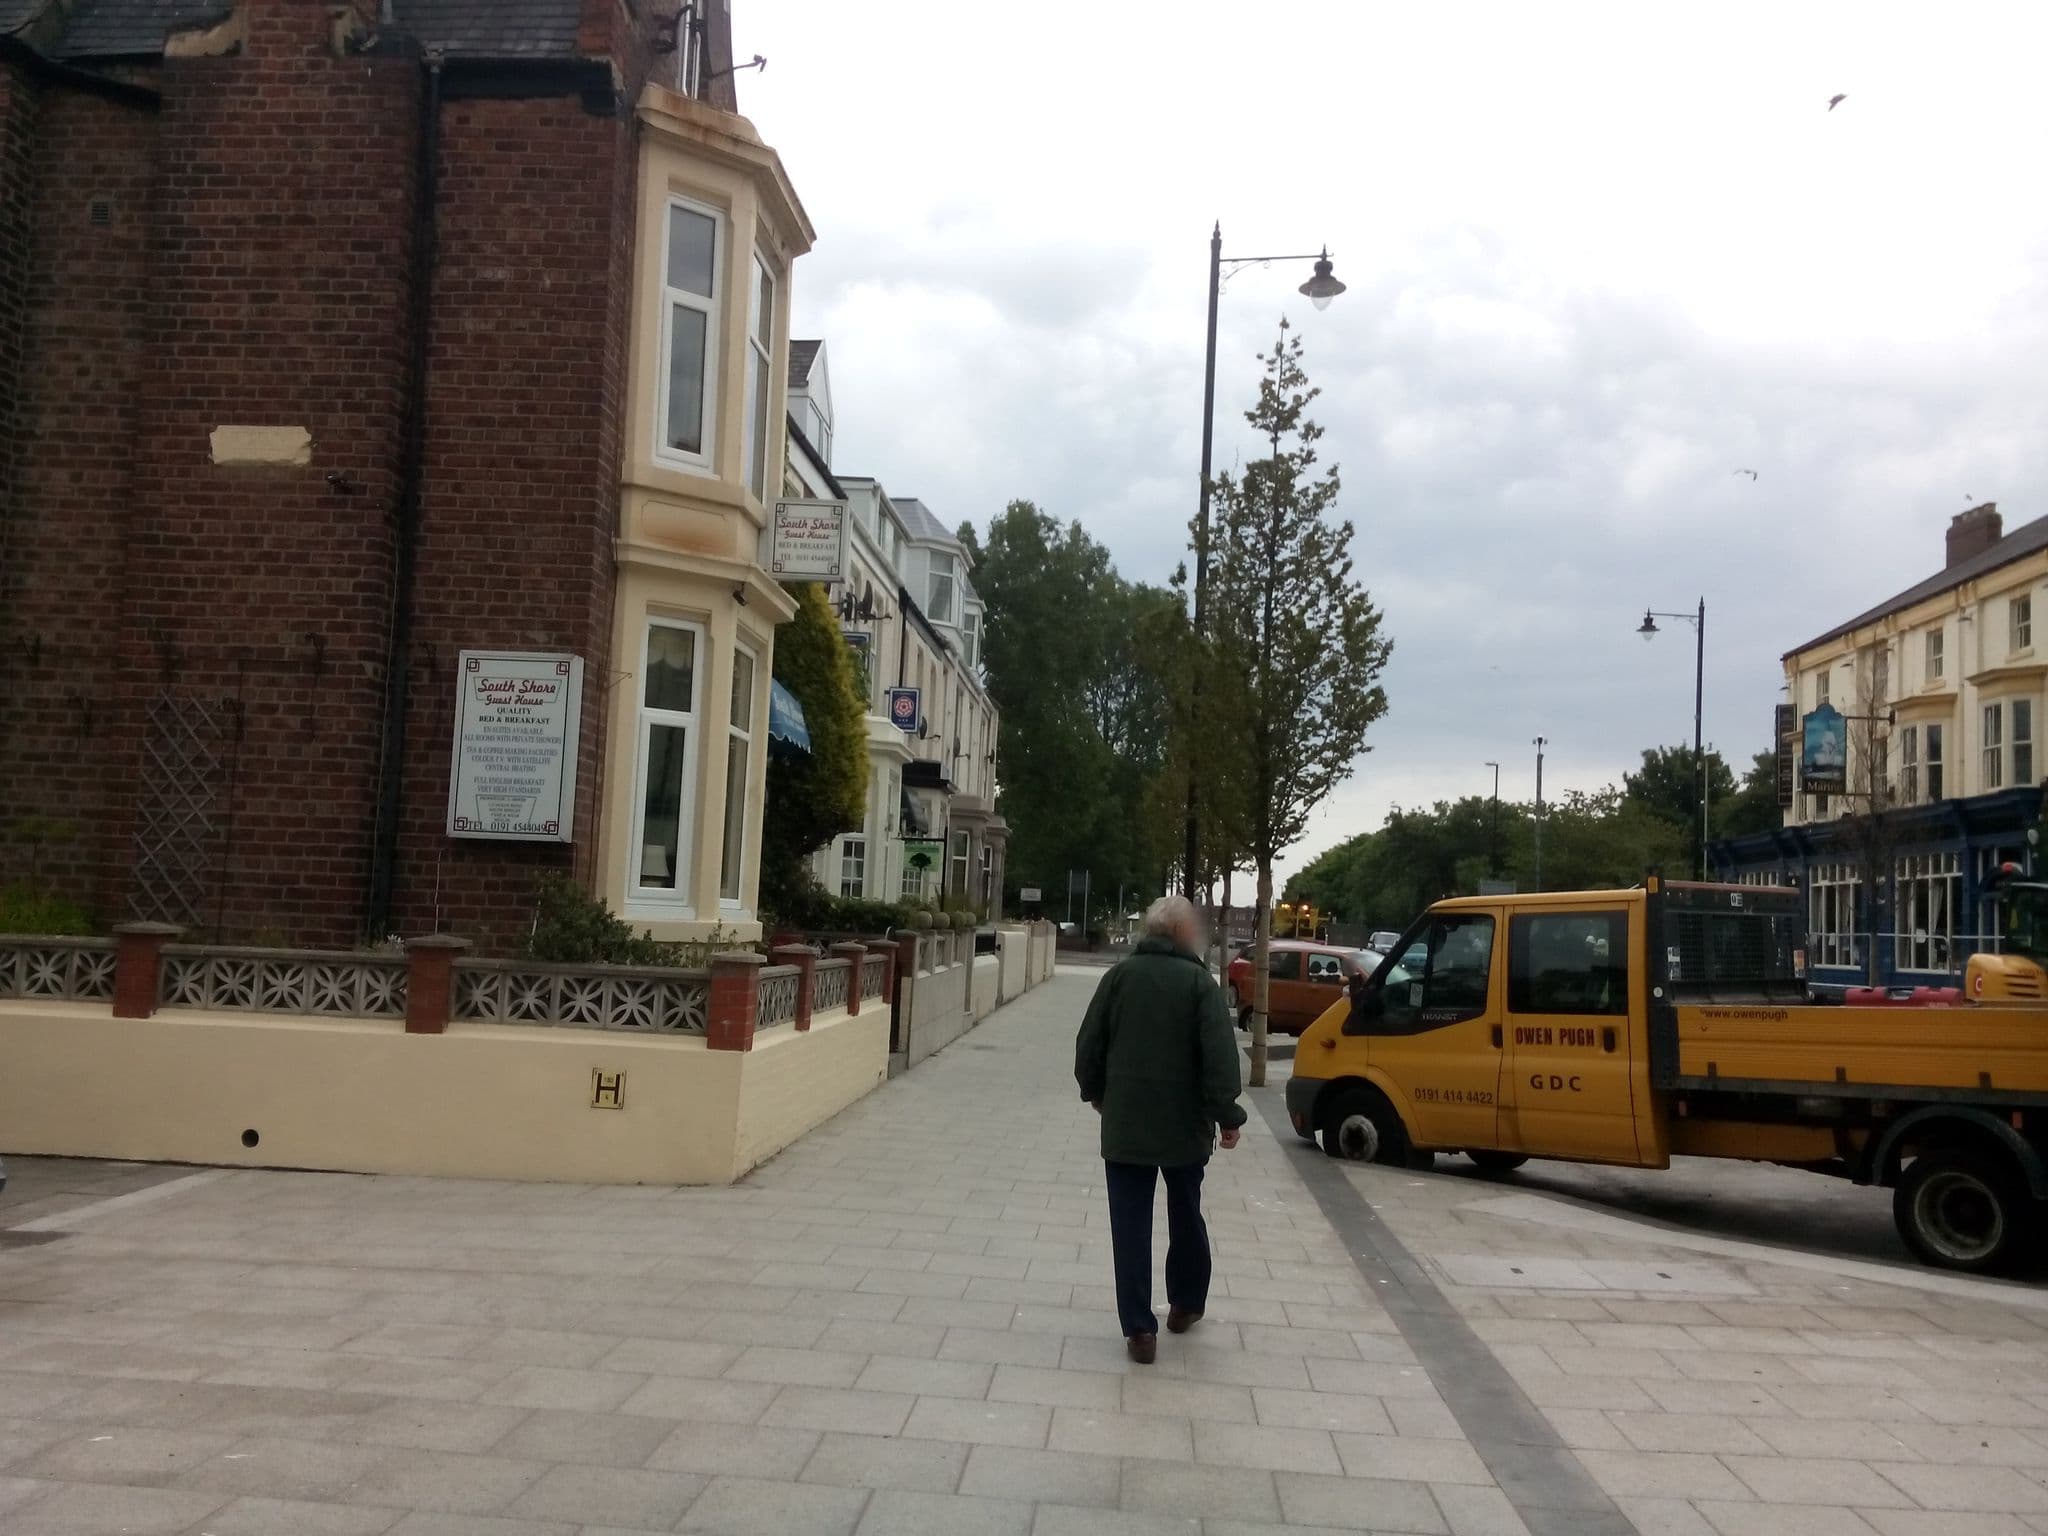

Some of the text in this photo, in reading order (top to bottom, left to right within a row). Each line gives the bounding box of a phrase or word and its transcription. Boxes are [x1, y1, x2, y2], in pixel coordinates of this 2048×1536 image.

[778, 517, 840, 530] South Shore
[784, 530, 830, 540] Guest House
[800, 543, 836, 551] BREAKFAST
[478, 679, 556, 694] South Shore
[485, 694, 544, 706] Guest House
[497, 707, 532, 715] QUALITY
[479, 715, 494, 723] BED
[504, 717, 550, 725] BREAKFAST
[512, 727, 543, 735] AVAILABLE
[485, 764, 537, 773] CENTRAL HEATING
[478, 785, 492, 793] VERY
[490, 822, 510, 832] 0191
[1514, 1027, 1595, 1047] OWEN PUGH
[1415, 1088, 1494, 1105] 0191 414 4422
